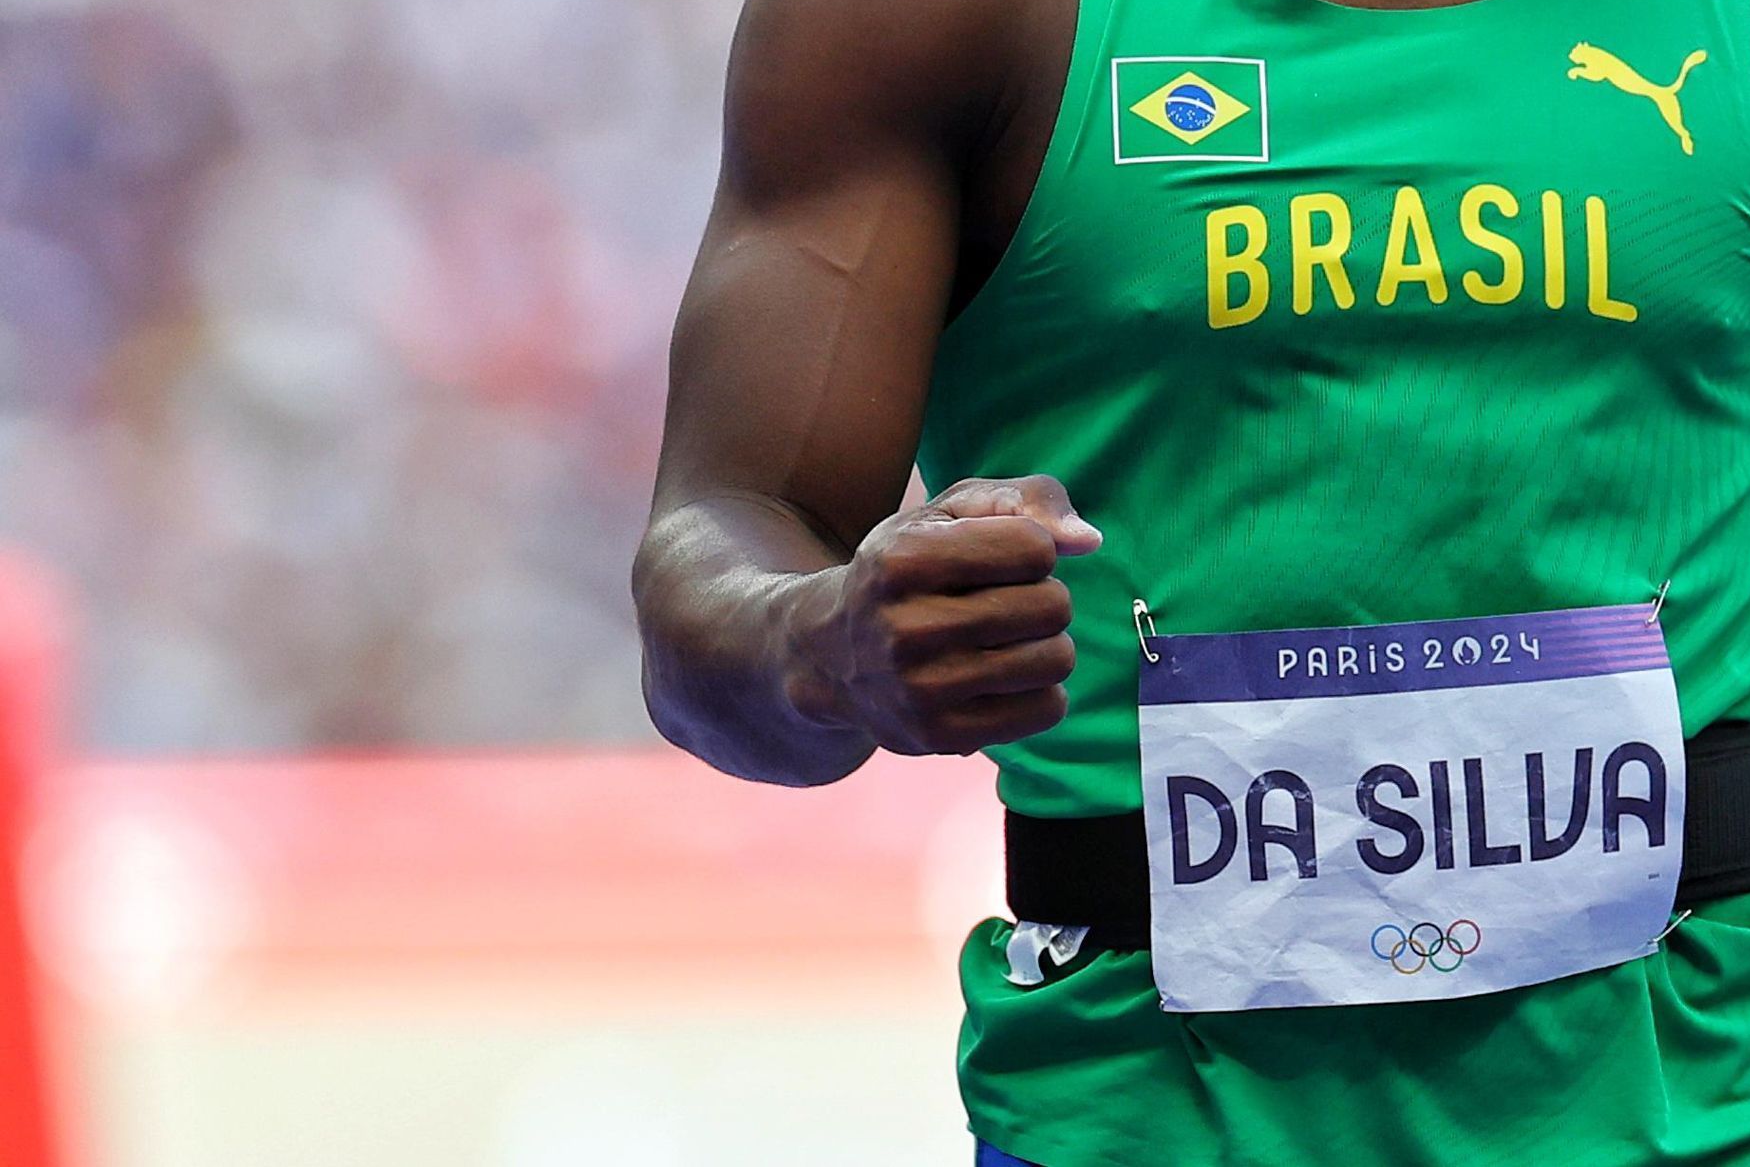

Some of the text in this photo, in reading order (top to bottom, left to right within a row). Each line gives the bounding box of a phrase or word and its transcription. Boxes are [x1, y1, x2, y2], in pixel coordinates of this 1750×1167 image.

[1206, 184, 1638, 330] BRASIL
[1423, 632, 1540, 669] 2024
[1166, 741, 1667, 885] DA SILVA
